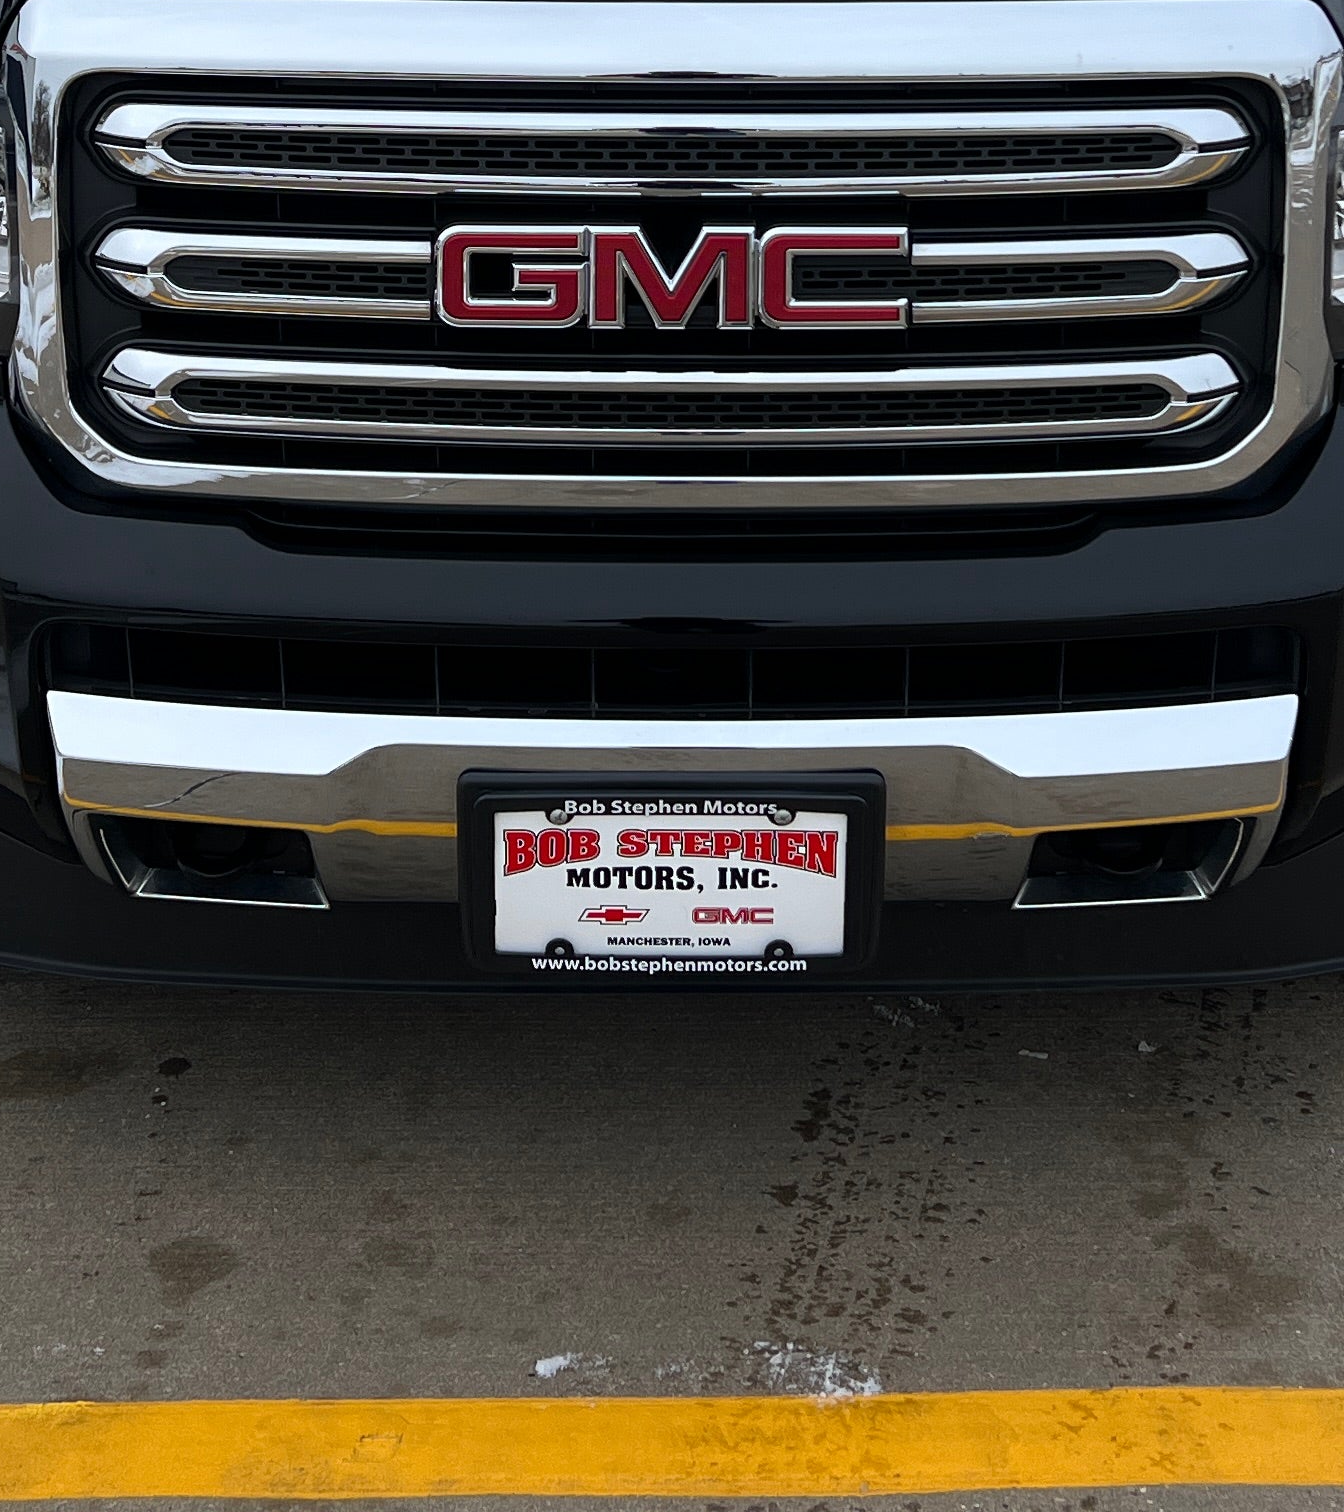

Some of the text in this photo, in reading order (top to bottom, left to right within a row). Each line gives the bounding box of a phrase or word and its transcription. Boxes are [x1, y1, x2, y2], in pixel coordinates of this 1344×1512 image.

[436, 224, 909, 330] GMC
[564, 799, 777, 817] Bob Stephen Motors
[503, 828, 839, 878] BOB STEPHEN
[566, 866, 778, 893] MOTORS, INC.
[691, 906, 774, 925] GMC
[607, 936, 731, 949] MANCHESTER, IOWA
[531, 956, 807, 975] www.bobstephenmotors.com
